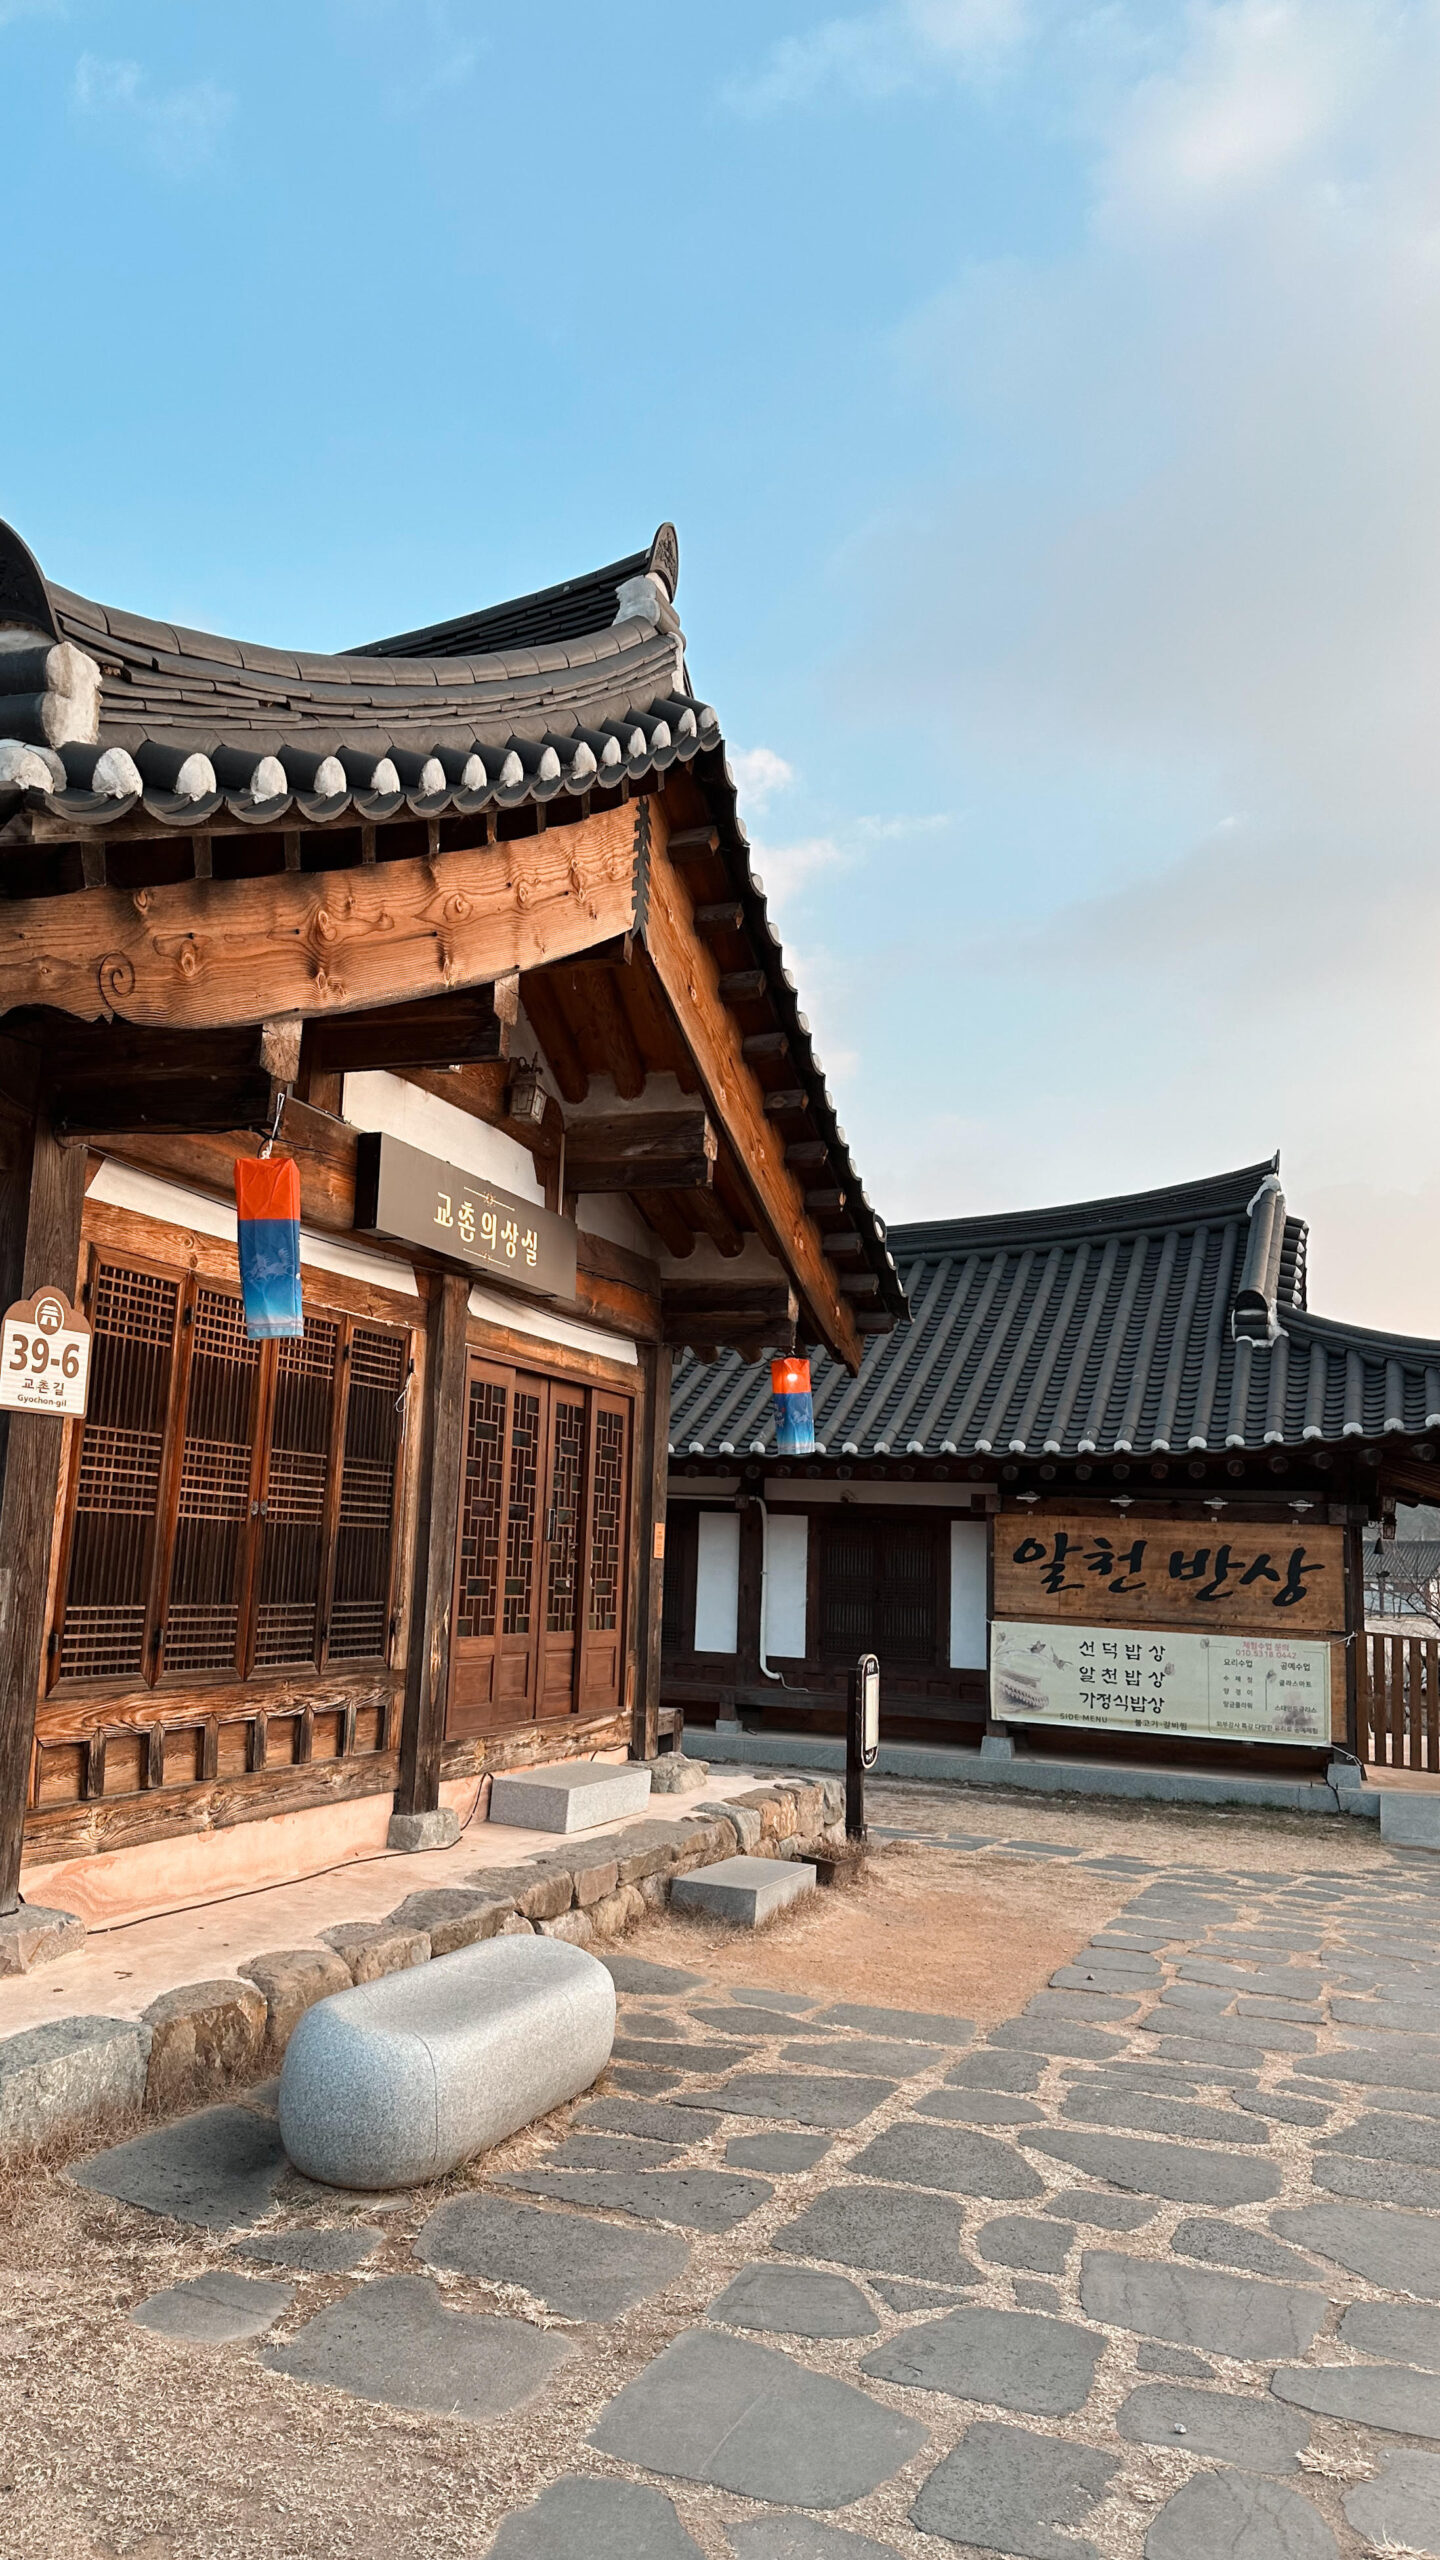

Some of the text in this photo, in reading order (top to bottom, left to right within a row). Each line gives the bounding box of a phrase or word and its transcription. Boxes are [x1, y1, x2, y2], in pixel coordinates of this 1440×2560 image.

[433, 1191, 538, 1267] 교촌의상실
[9, 1334, 80, 1378] 39-6
[22, 1378, 65, 1396] 교촌길
[17, 1394, 67, 1407] Gyochon-gil
[1012, 1532, 1149, 1594] 알천
[1235, 1649, 1251, 1657] 010
[1223, 1659, 1253, 1668] 요리수업
[1281, 1662, 1311, 1671] 공예수업
[1079, 1692, 1166, 1714] 가정식밥상
[1060, 1713, 1108, 1723] SIDE MENU
